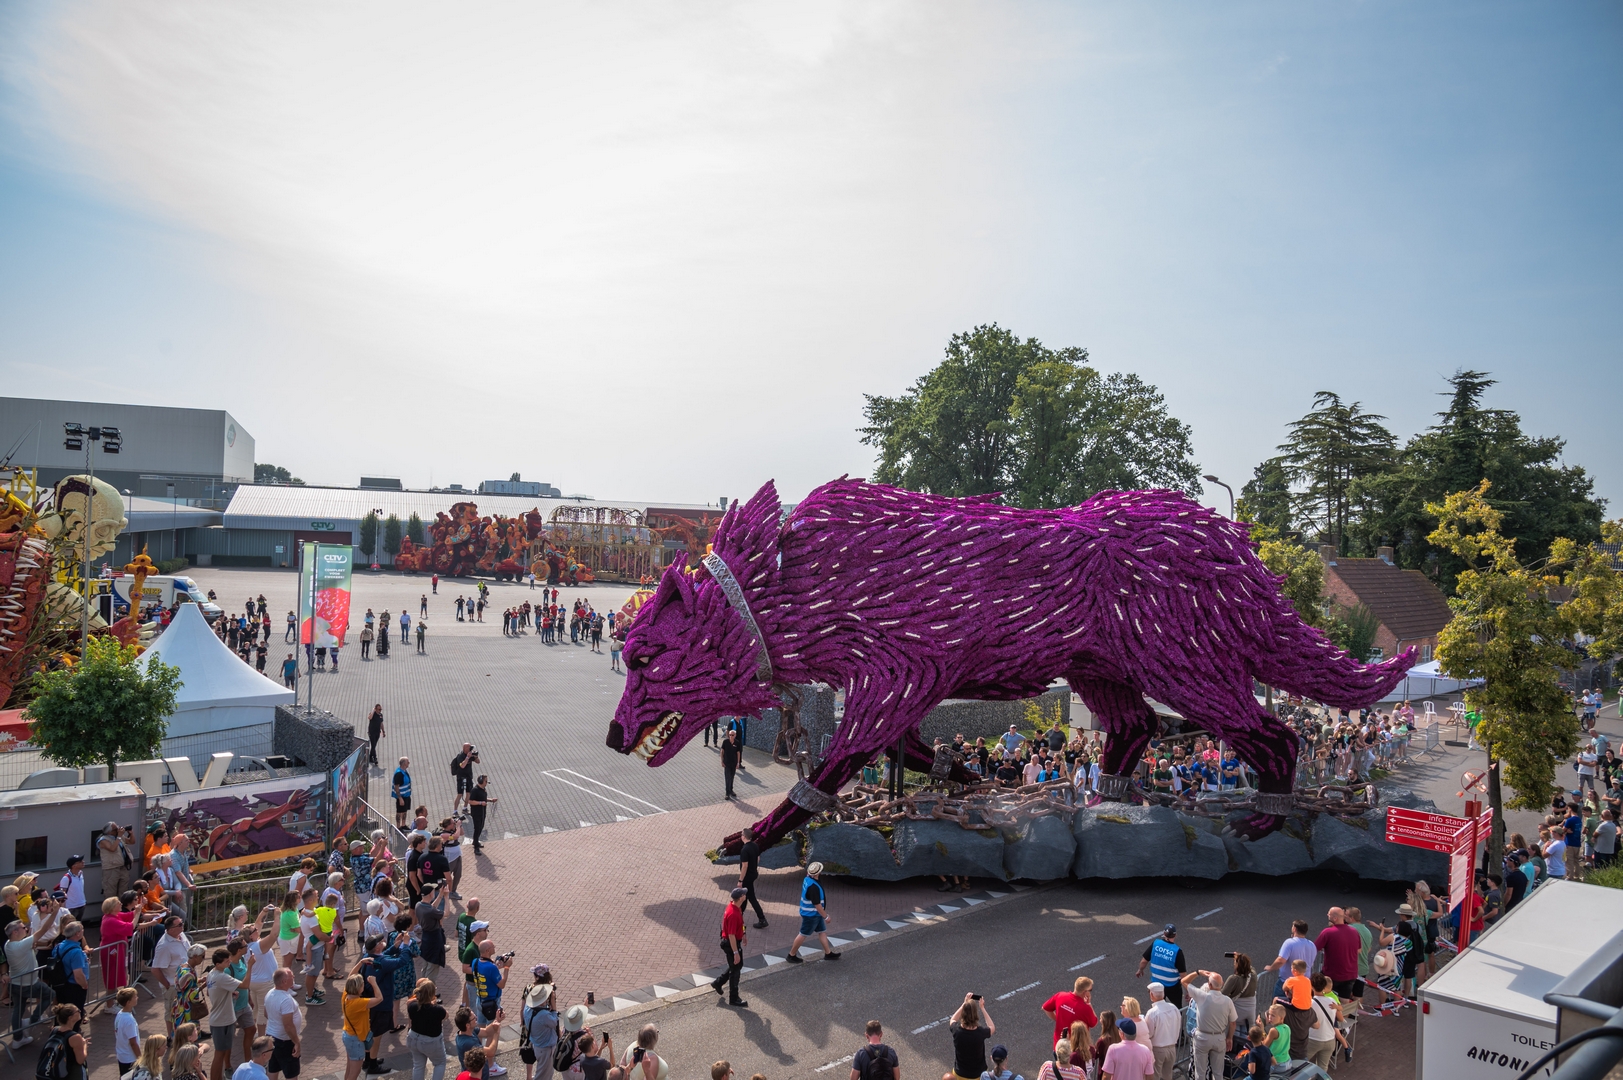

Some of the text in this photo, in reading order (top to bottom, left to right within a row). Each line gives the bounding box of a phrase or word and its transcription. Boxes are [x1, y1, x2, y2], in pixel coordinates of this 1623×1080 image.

[1428, 815, 1443, 823] info
[1445, 818, 1466, 826] stand
[1434, 844, 1450, 852] e.h.
[1155, 946, 1174, 956] corso
